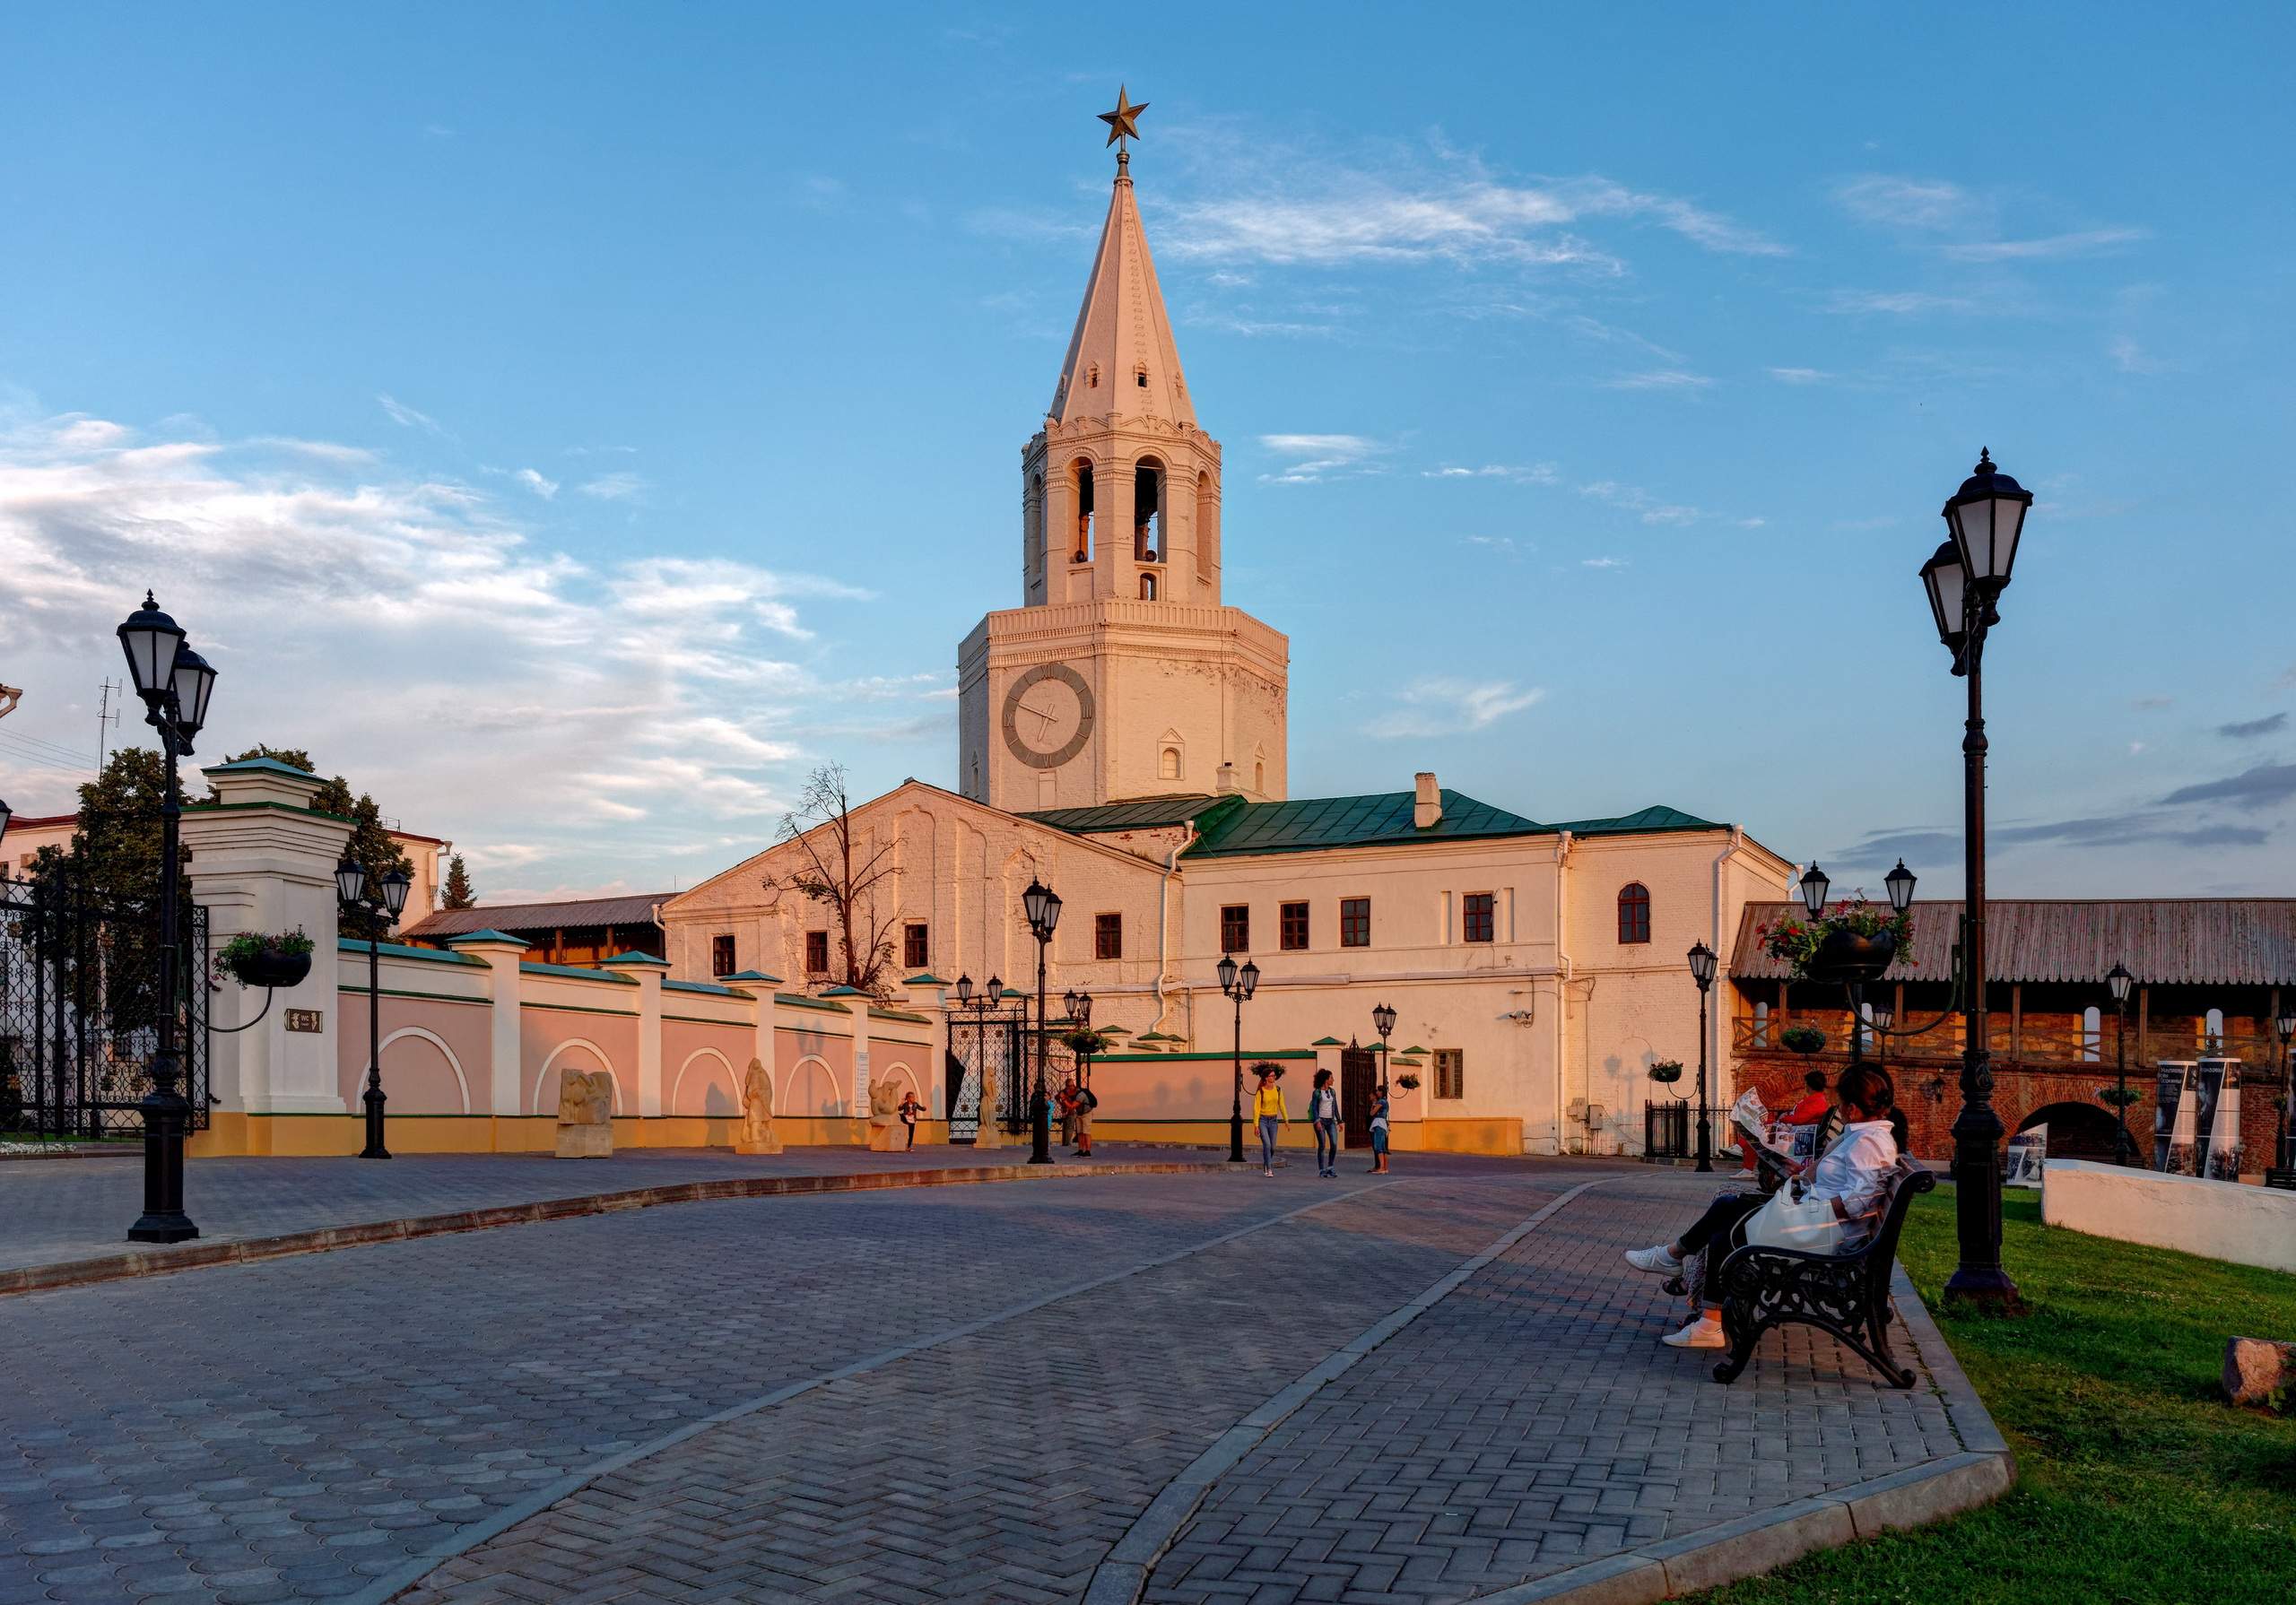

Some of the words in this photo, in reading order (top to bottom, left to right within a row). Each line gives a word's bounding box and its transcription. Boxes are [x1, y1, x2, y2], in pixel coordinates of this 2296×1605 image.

[1083, 705, 1092, 719] III
[1004, 713, 1013, 727] IX
[1043, 754, 1053, 768] VI
